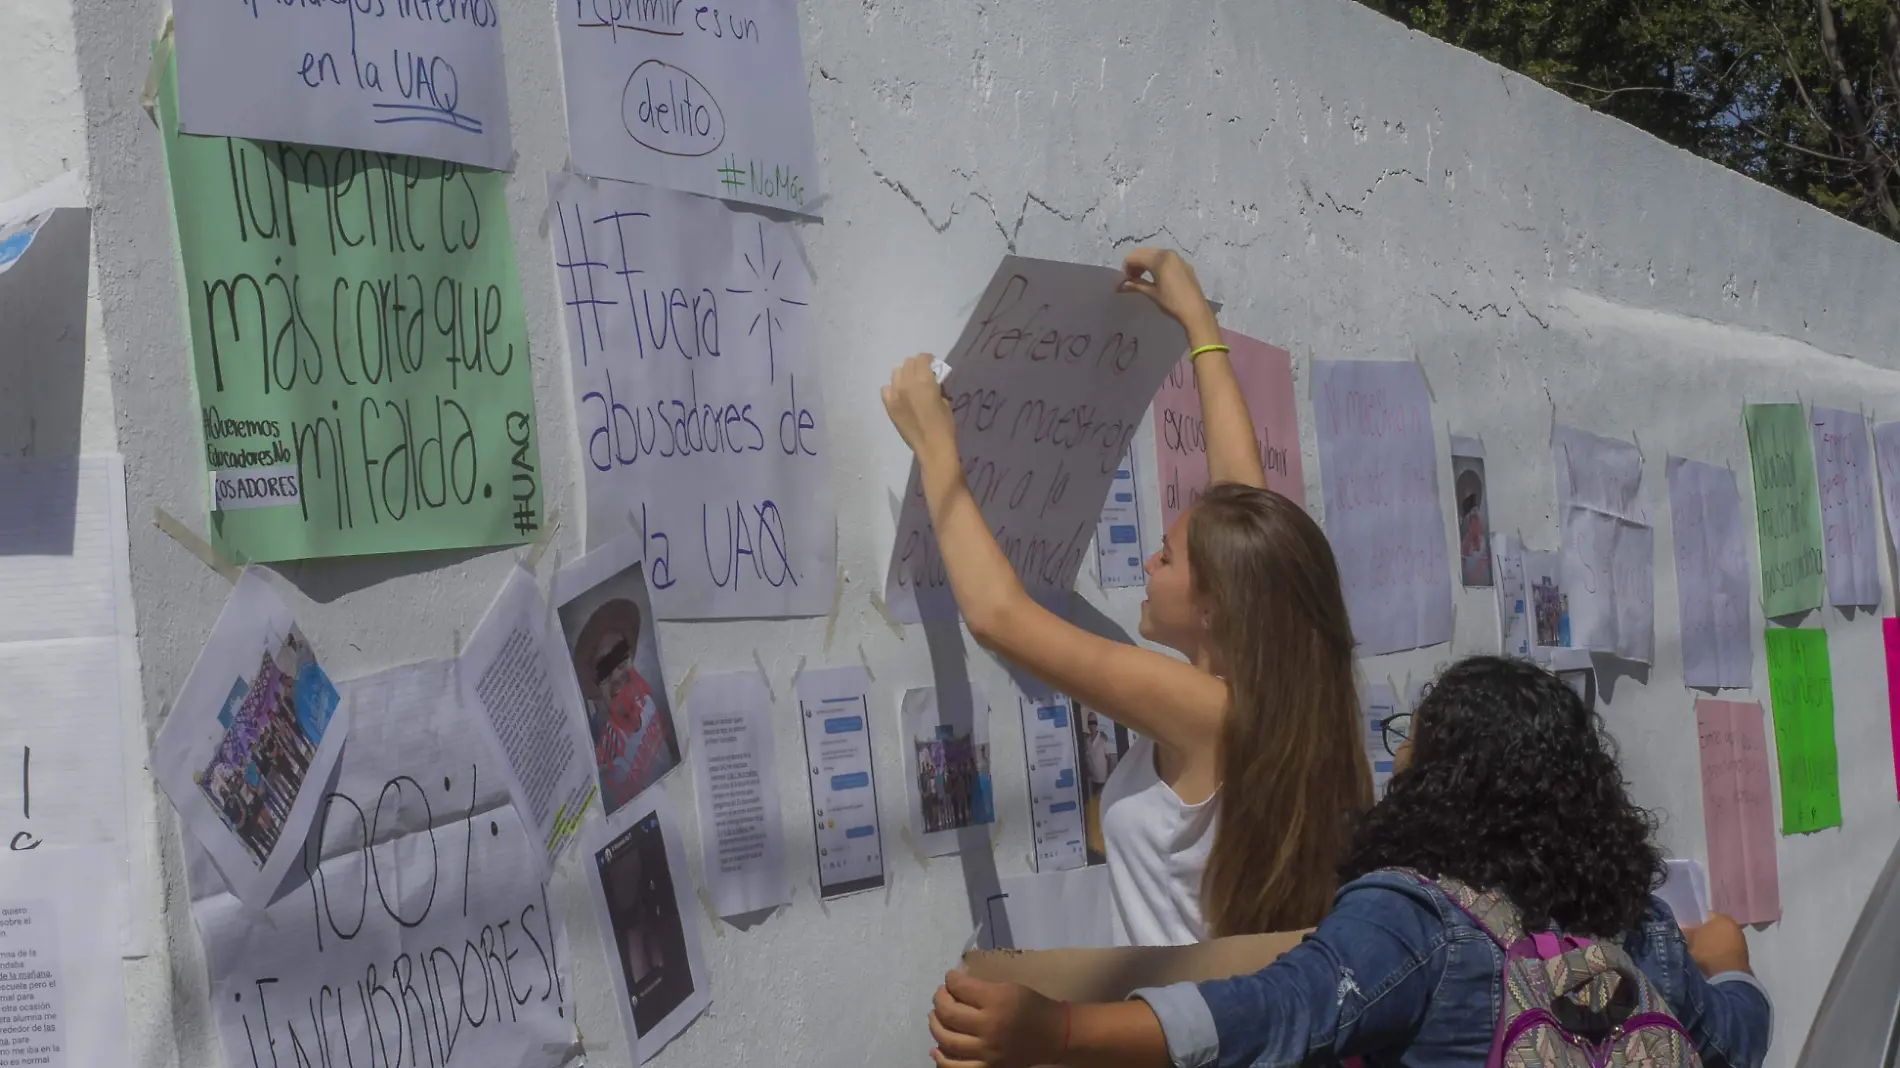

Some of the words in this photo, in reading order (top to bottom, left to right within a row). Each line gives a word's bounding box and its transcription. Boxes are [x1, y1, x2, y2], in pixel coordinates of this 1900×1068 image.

[695, 6, 722, 38] es
[729, 14, 759, 43] un
[298, 52, 340, 88] en
[352, 49, 383, 91] la
[394, 49, 460, 123] UAQ
[557, 200, 721, 368] #Fuera
[203, 255, 324, 394] más
[334, 273, 426, 386] corta
[434, 275, 513, 390] que
[951, 387, 1006, 432] ener
[582, 368, 764, 472] abusadores
[779, 372, 818, 456] de
[1163, 407, 1207, 456] excus
[291, 400, 353, 530] mi
[506, 411, 538, 536] #UAQ
[642, 502, 677, 590] la
[2, 908, 28, 916] quiero
[24, 916, 31, 925] el
[18, 949, 28, 958] de
[29, 948, 37, 957] la
[29, 982, 48, 990] pero
[49, 980, 56, 988] el
[17, 993, 35, 1002] para
[2, 1004, 18, 1013] otra
[19, 1001, 51, 1012] ocasión
[13, 1013, 43, 1022] alumna
[32, 1024, 42, 1032] de
[43, 1024, 56, 1032] las
[12, 1036, 30, 1045] para
[12, 1047, 25, 1055] me
[53, 1044, 61, 1053] la
[10, 1057, 20, 1066] es
[22, 1055, 50, 1065] normal
